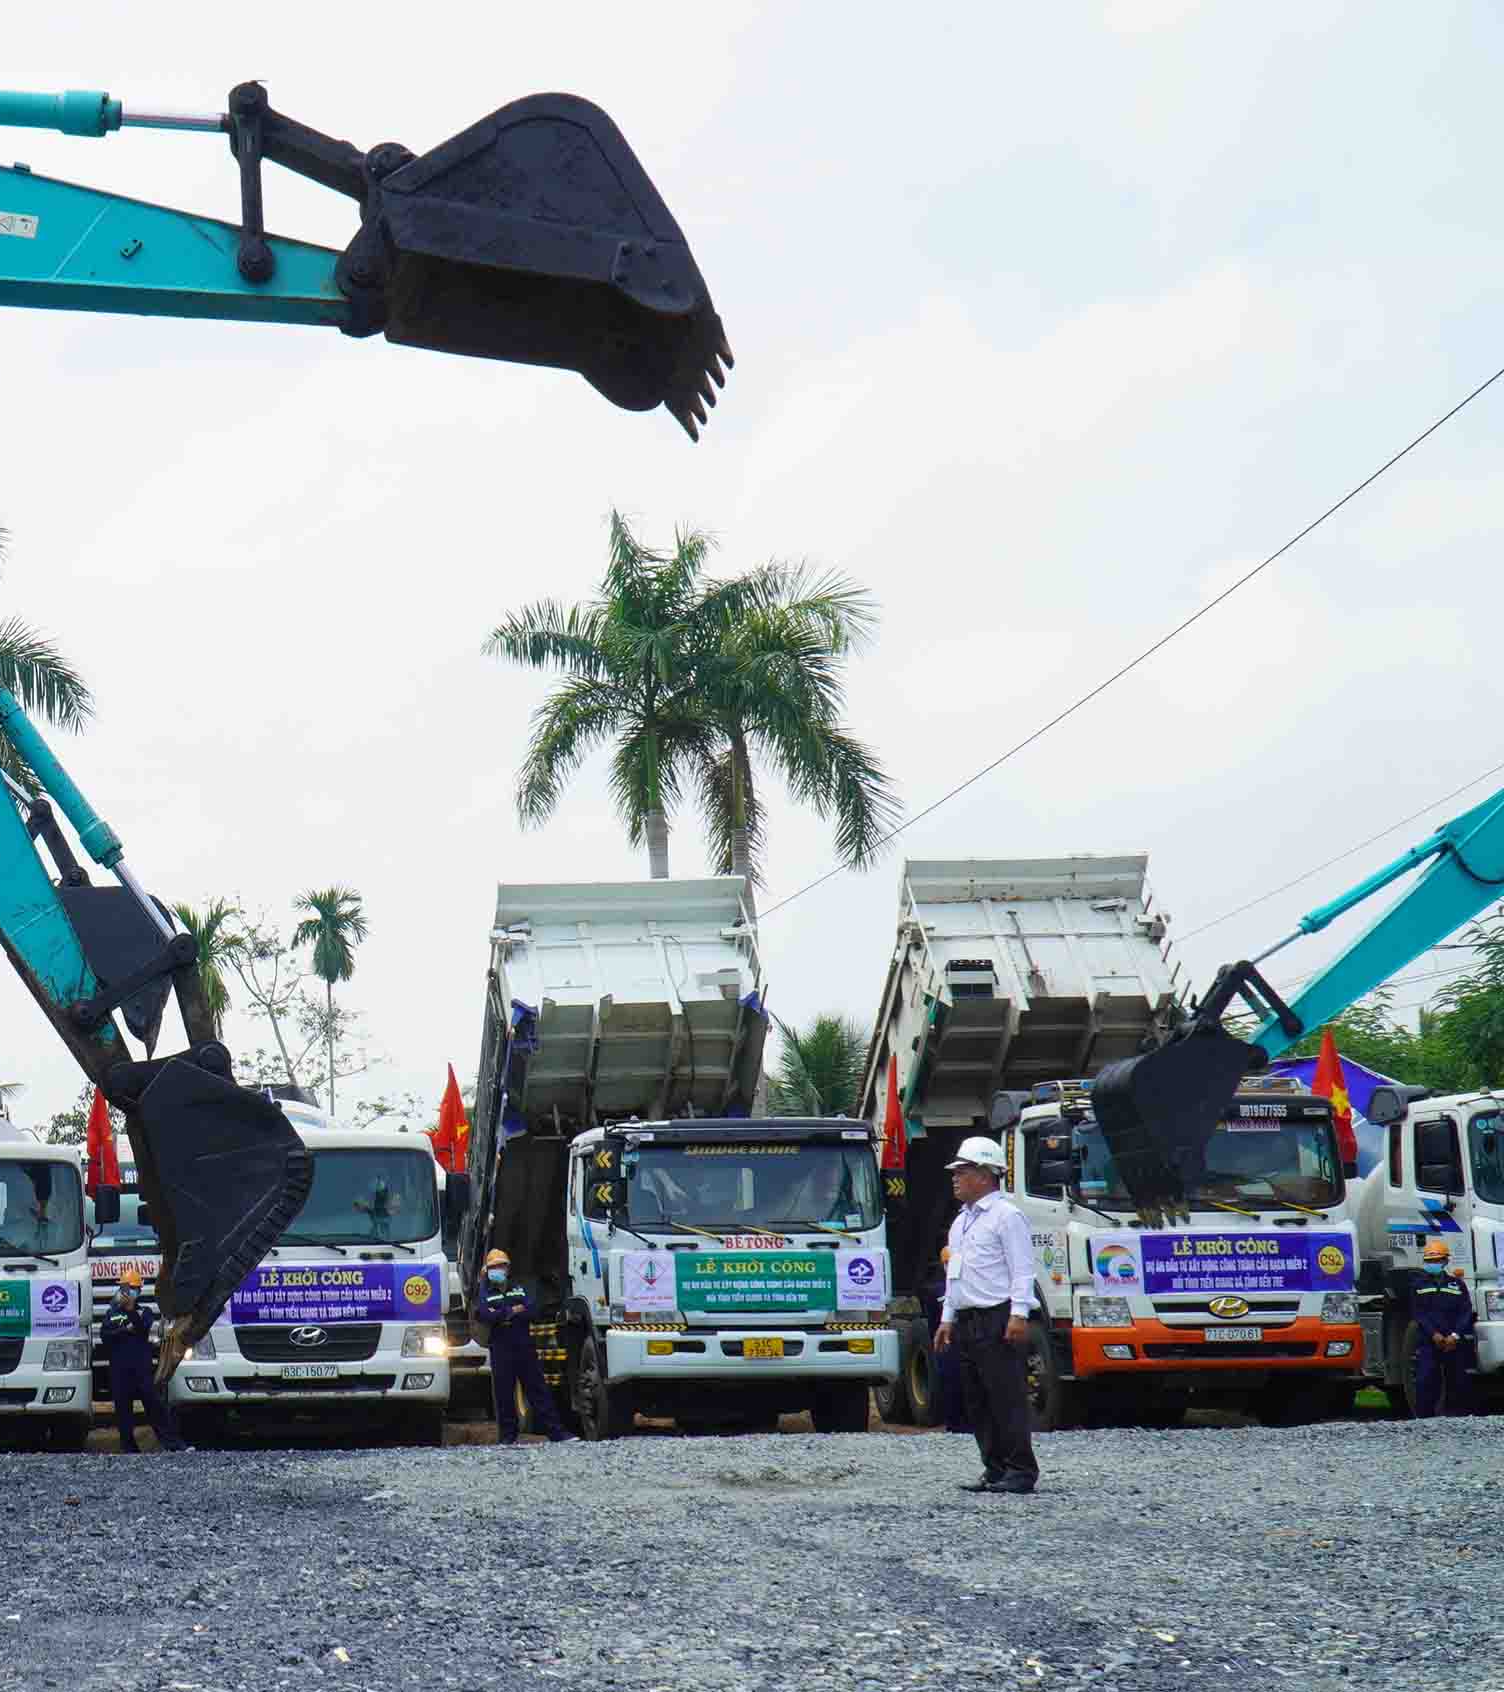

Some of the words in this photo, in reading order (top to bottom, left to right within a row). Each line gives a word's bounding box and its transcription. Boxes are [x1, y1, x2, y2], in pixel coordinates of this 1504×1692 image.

[1172, 1235, 1193, 1256] LỄ
[1196, 1235, 1233, 1256] KHỞI
[1235, 1236, 1280, 1255] CÔNG
[696, 1257, 717, 1274] LỄ
[721, 1256, 765, 1274] KHỞI
[770, 1259, 816, 1273] CÔNG
[1320, 1254, 1344, 1266] C92
[260, 1267, 279, 1287] LỄ
[282, 1267, 318, 1287] KHỞI
[321, 1267, 364, 1286] CÔNG
[406, 1284, 430, 1296] C92
